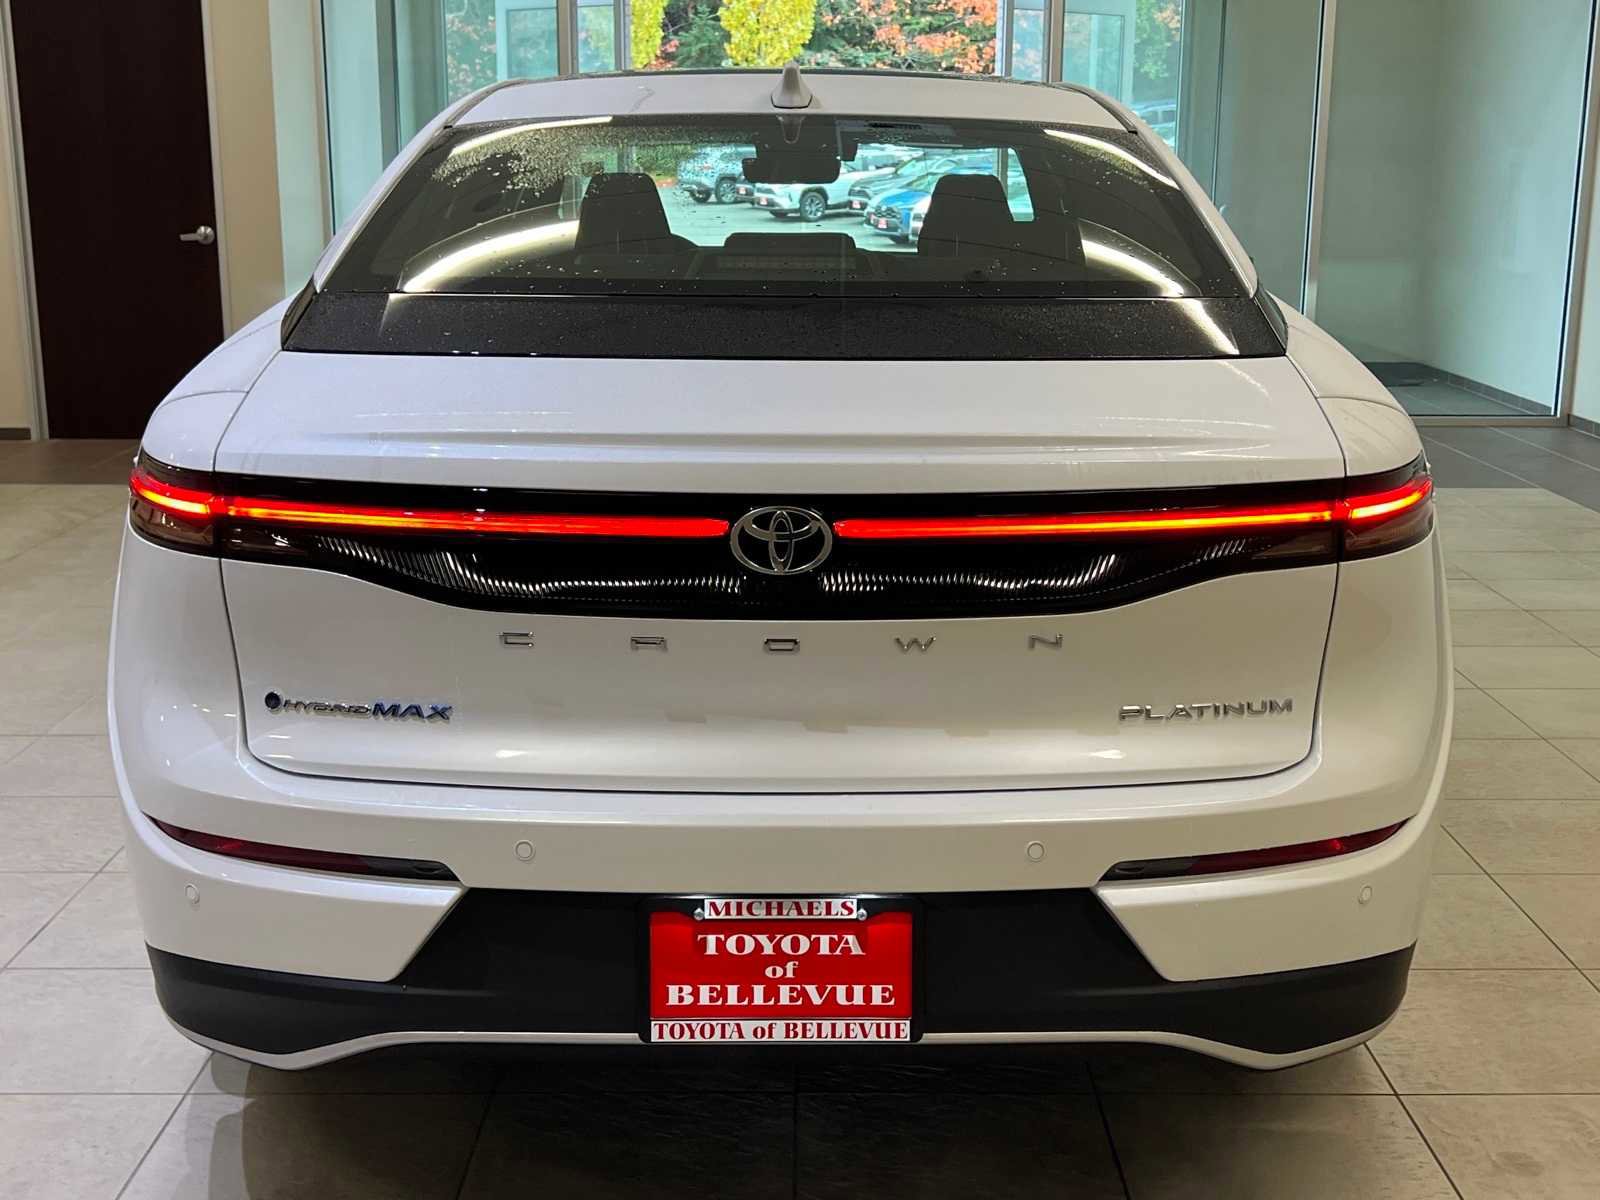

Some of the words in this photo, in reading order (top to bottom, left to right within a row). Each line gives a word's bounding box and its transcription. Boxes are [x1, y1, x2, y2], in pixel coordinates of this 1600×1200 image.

[1119, 699, 1293, 721] PLATINUM
[708, 900, 855, 917] MICHAELS
[697, 934, 866, 956] TOYOTA
[764, 961, 799, 979] of
[665, 984, 896, 1006] BELLEVUE
[653, 1022, 745, 1040] TOYOTA
[752, 1022, 777, 1040] of
[783, 1022, 907, 1040] BELLEVUE
